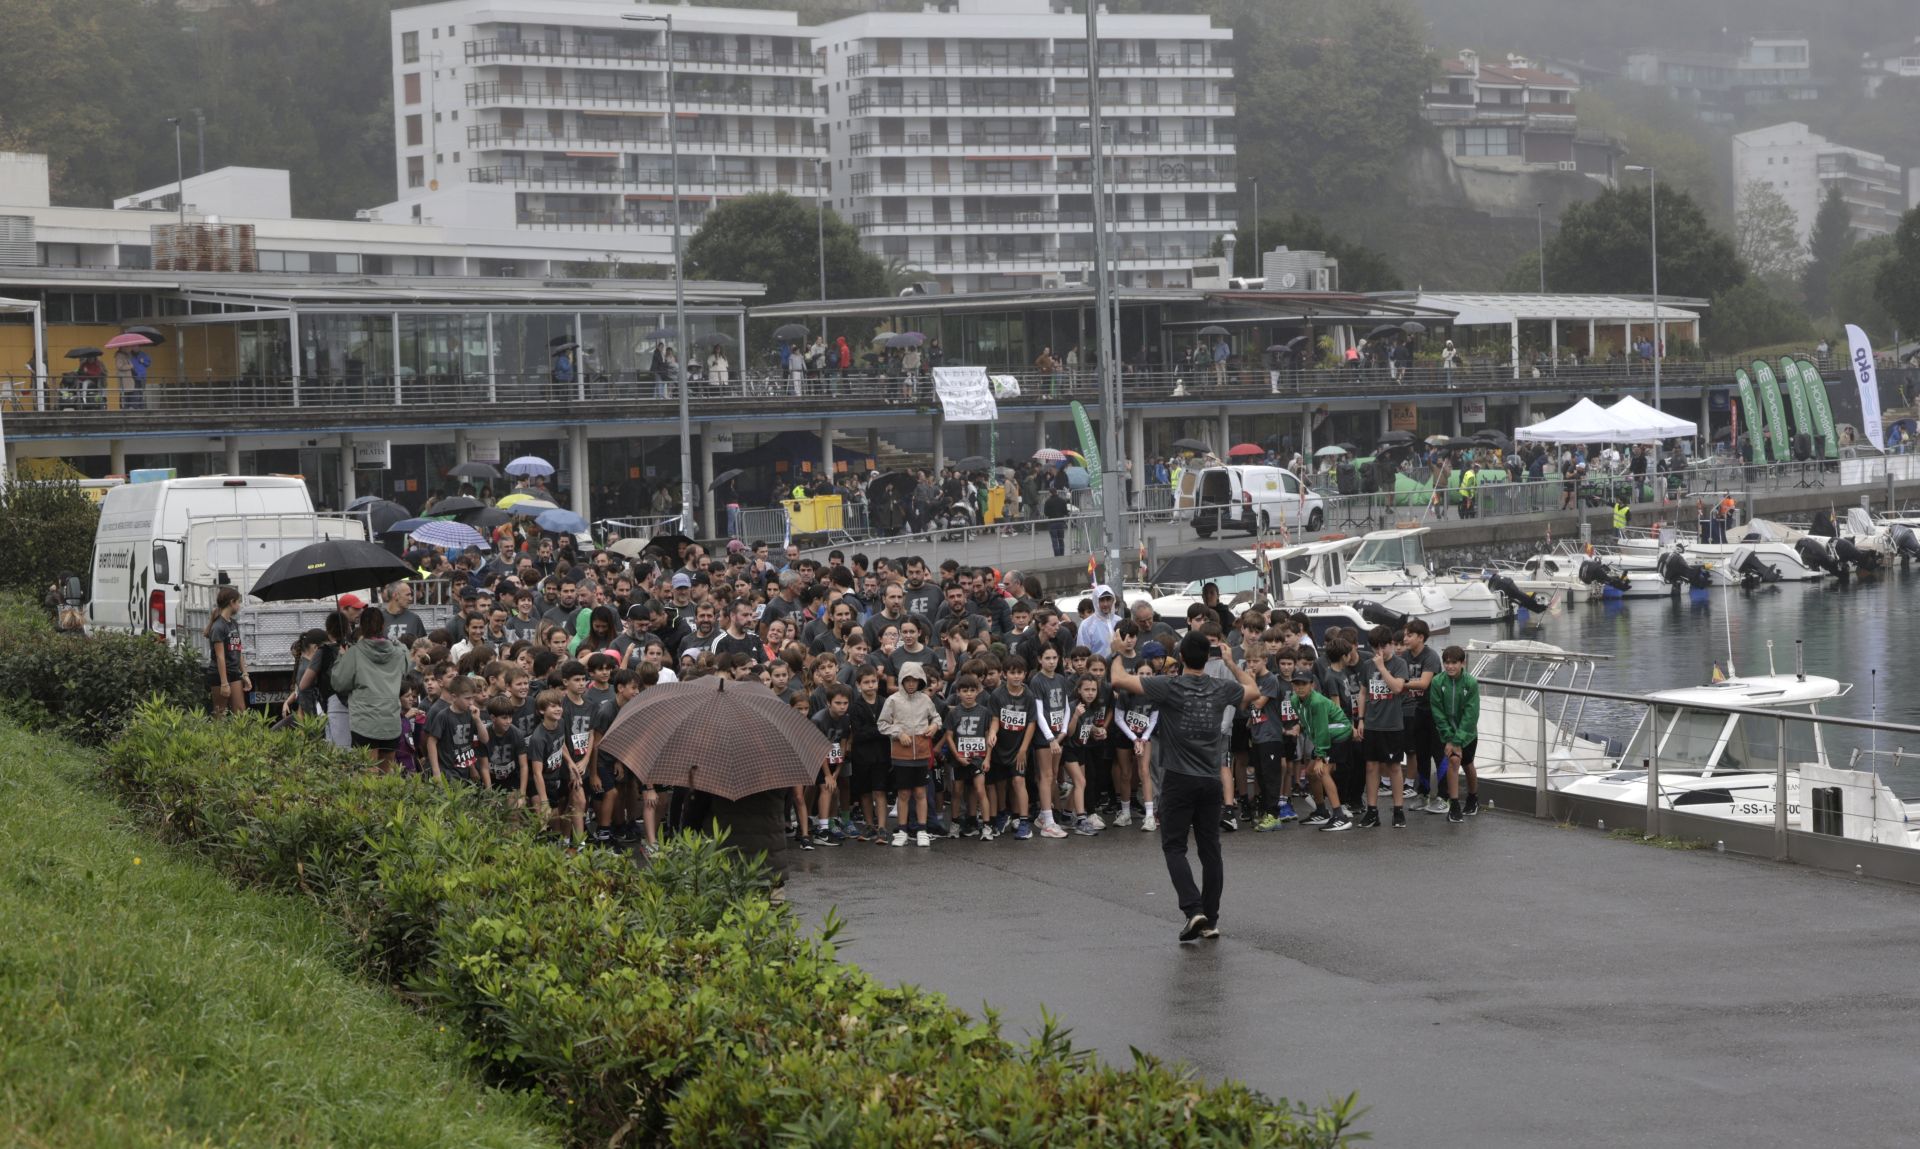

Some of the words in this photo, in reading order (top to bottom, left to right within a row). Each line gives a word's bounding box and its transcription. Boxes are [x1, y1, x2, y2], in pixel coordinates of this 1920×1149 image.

[1001, 714, 1024, 725] 2064
[959, 743, 984, 751] 1926
[456, 748, 475, 763] 1110
